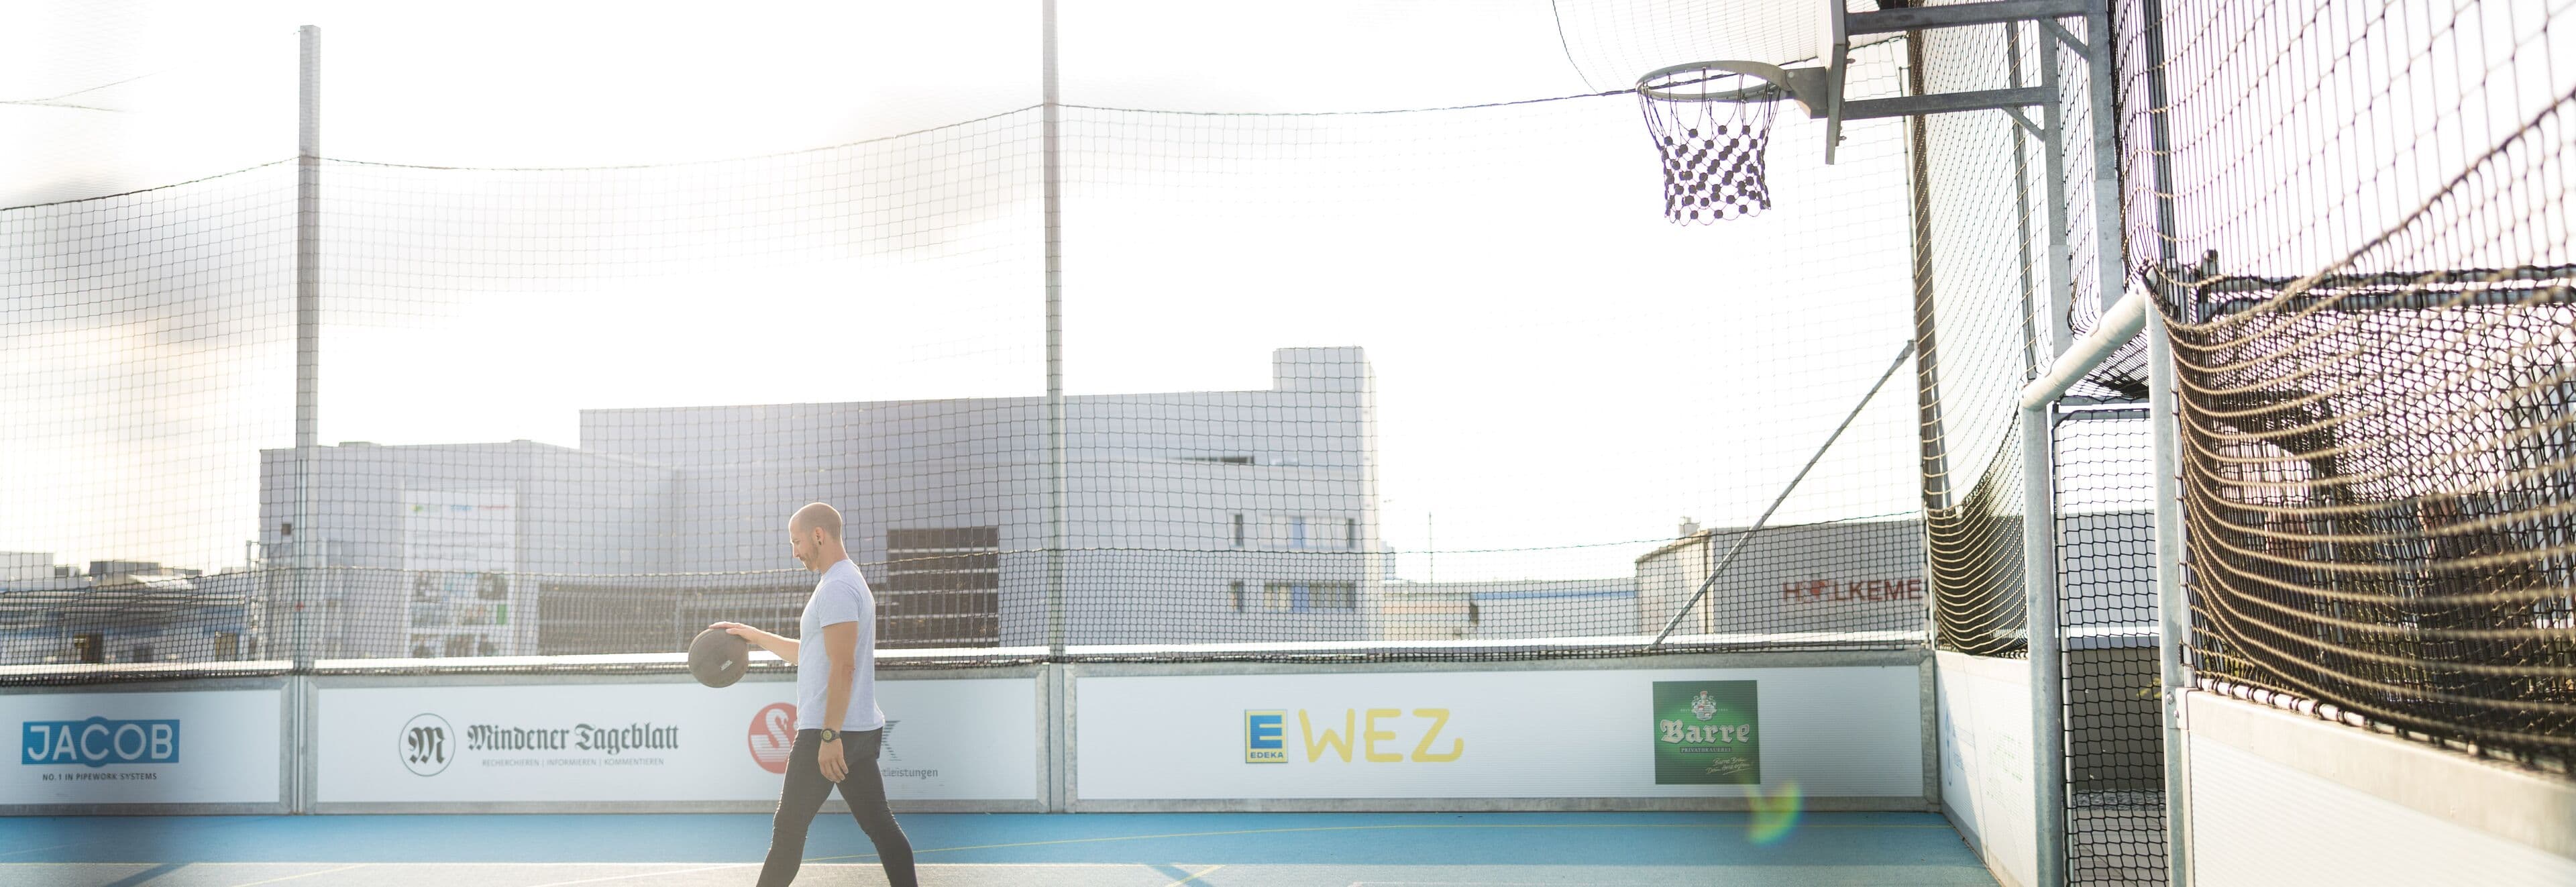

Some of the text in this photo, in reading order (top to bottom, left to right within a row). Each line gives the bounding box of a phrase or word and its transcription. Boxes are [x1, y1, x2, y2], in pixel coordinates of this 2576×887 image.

[28, 723, 173, 761] JACOB
[468, 723, 680, 755] Mindener Tageblatt
[1298, 708, 1464, 763] WEZ
[1660, 719, 1750, 744] Barre
[482, 758, 664, 767] RECHERCHIEREN INFORMIEREN KOMMENTIEREN
[76, 773, 117, 781] PIPEWORK
